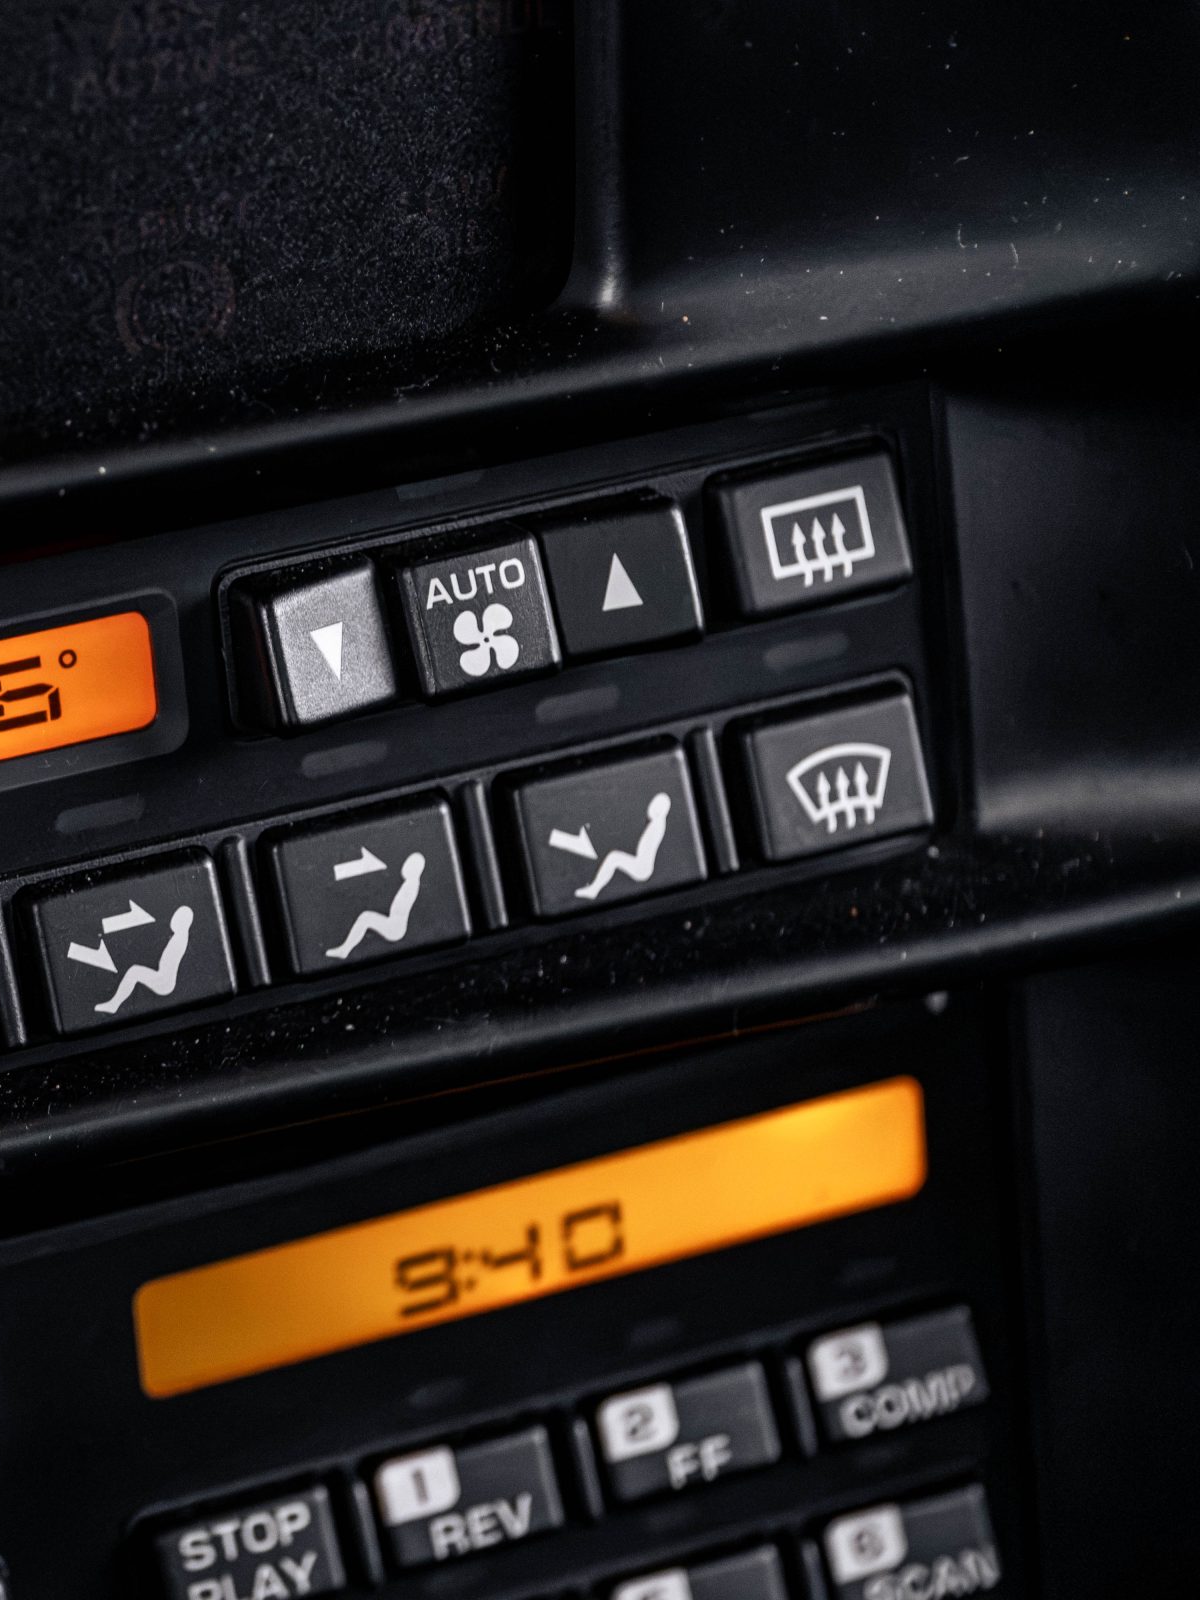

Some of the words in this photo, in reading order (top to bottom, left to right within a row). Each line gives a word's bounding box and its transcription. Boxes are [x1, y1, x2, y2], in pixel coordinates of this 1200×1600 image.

[427, 558, 525, 610] AUTO
[396, 1200, 625, 1316] 9:40
[622, 1403, 653, 1442] 2
[840, 1363, 976, 1439] COMP
[667, 1433, 733, 1489] FF
[178, 1501, 311, 1571] STOP
[429, 1493, 533, 1561] REV
